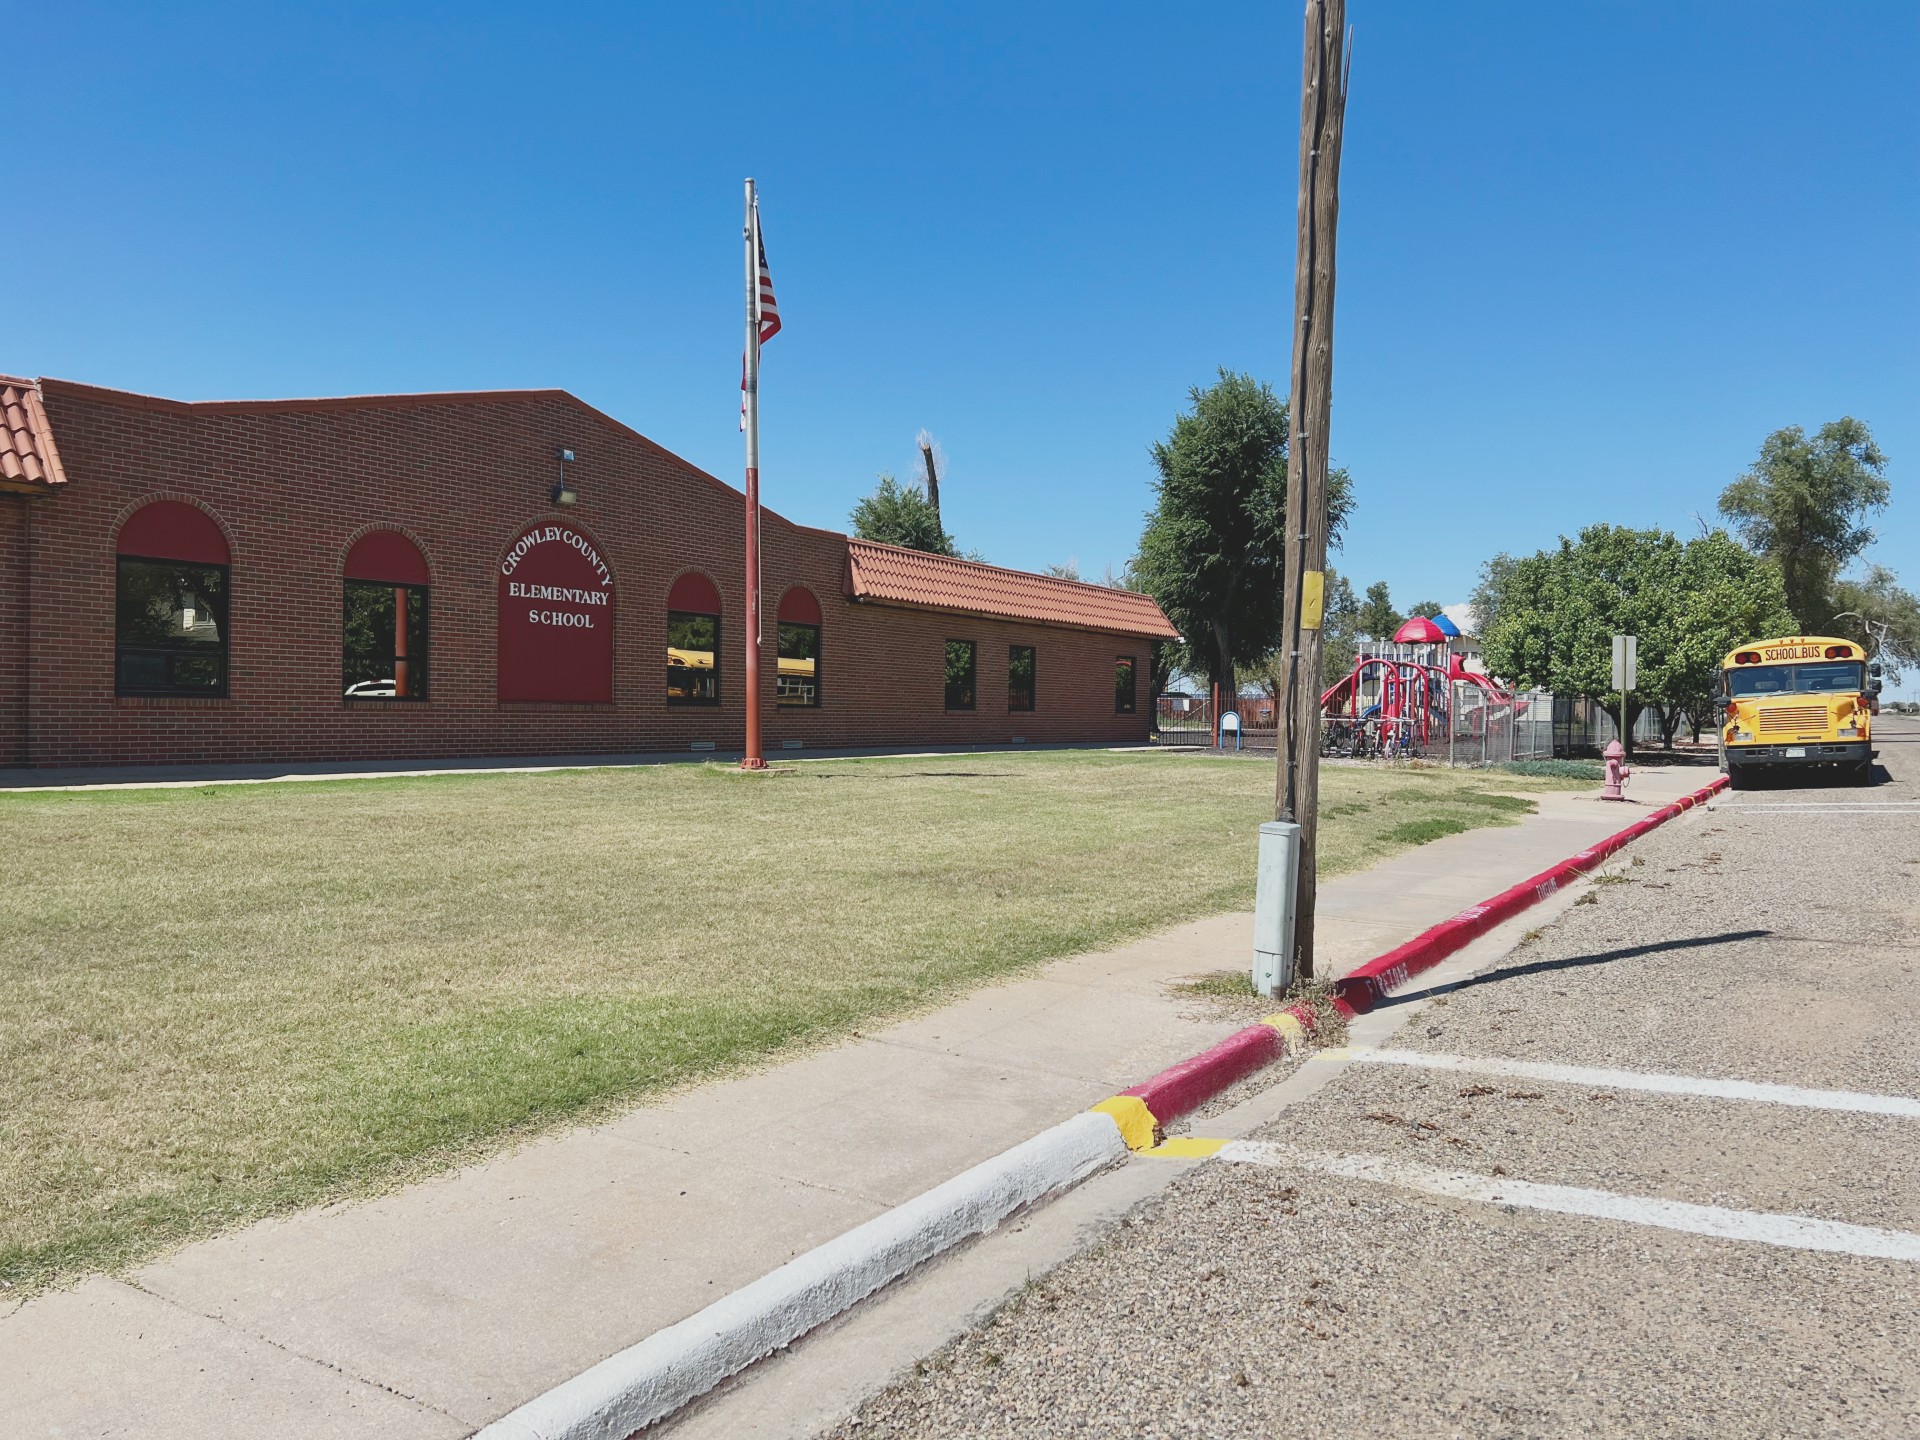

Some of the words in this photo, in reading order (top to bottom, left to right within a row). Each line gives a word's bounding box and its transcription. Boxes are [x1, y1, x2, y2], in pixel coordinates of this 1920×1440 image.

[501, 527, 563, 576] CROWLEY
[562, 530, 613, 587] COUNTY
[509, 582, 609, 606] ELEMENTARY
[529, 609, 595, 629] SCHOOL
[1765, 647, 1801, 661] SCHOOL
[1801, 645, 1821, 659] BUS
